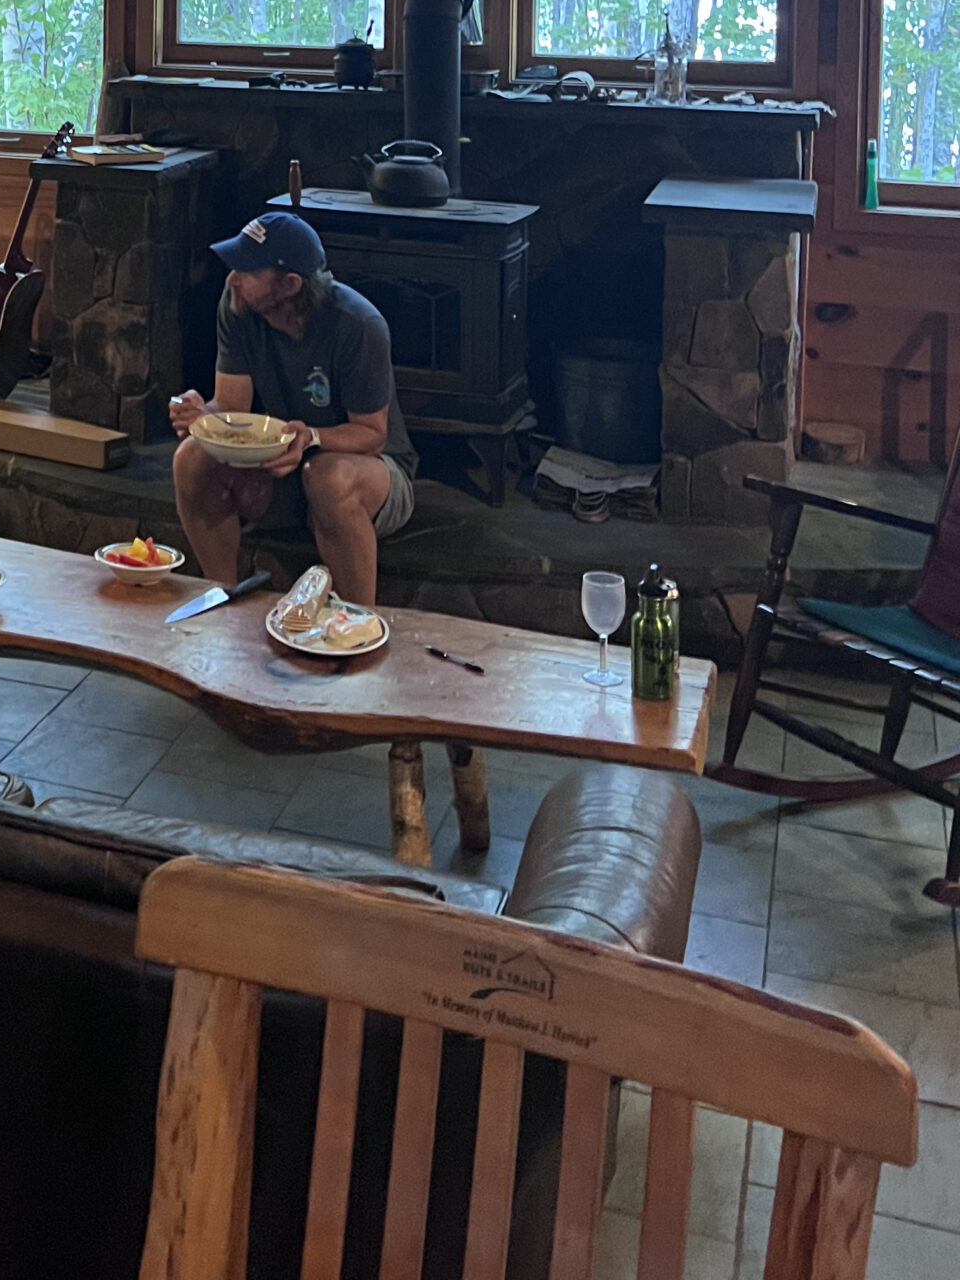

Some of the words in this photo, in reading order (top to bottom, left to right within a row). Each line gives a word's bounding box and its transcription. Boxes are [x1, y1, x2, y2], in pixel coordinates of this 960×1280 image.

[506, 971, 546, 993] TRAILS
[442, 995, 480, 1019] Memory
[483, 1008, 496, 1023] of
